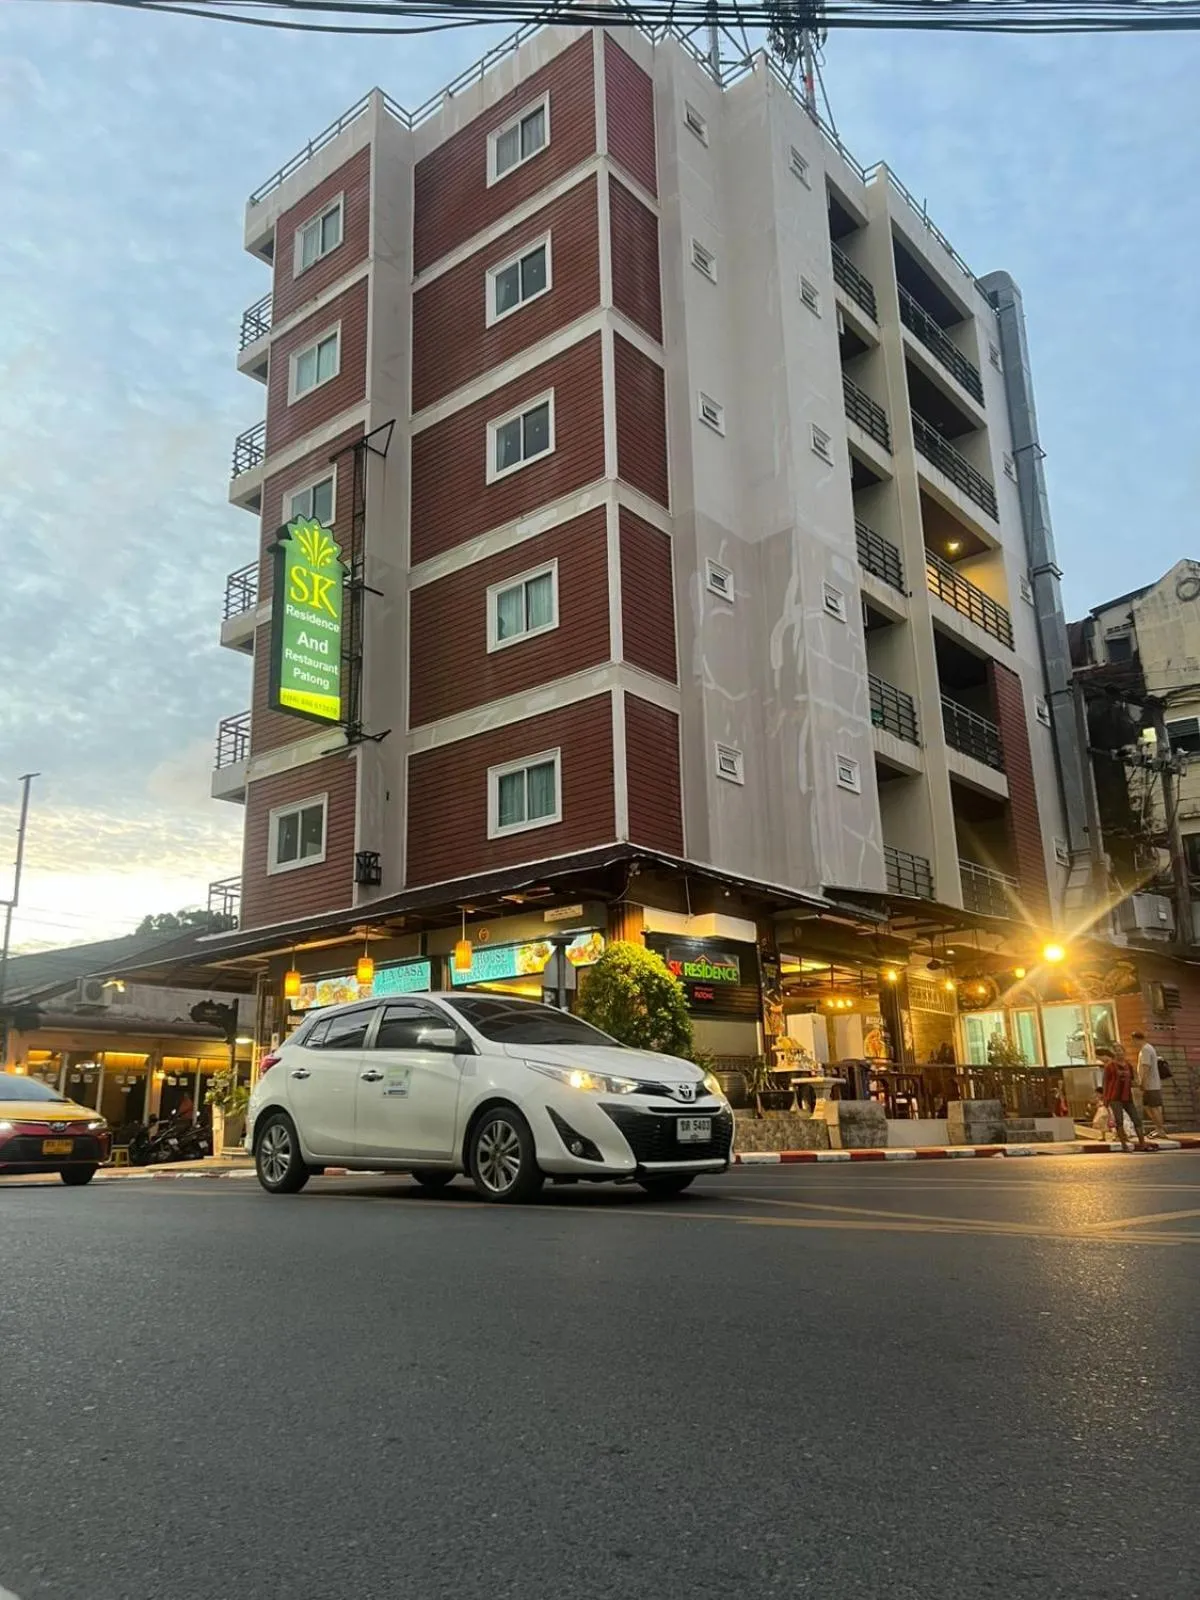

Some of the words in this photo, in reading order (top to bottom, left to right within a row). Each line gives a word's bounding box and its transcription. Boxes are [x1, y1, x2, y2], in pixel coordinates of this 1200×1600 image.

[290, 566, 338, 618] SK
[286, 604, 340, 633] Residence
[296, 631, 329, 655] And
[285, 648, 339, 676] Restaurant
[668, 960, 683, 976] SK
[684, 961, 738, 982] RESIDENCE
